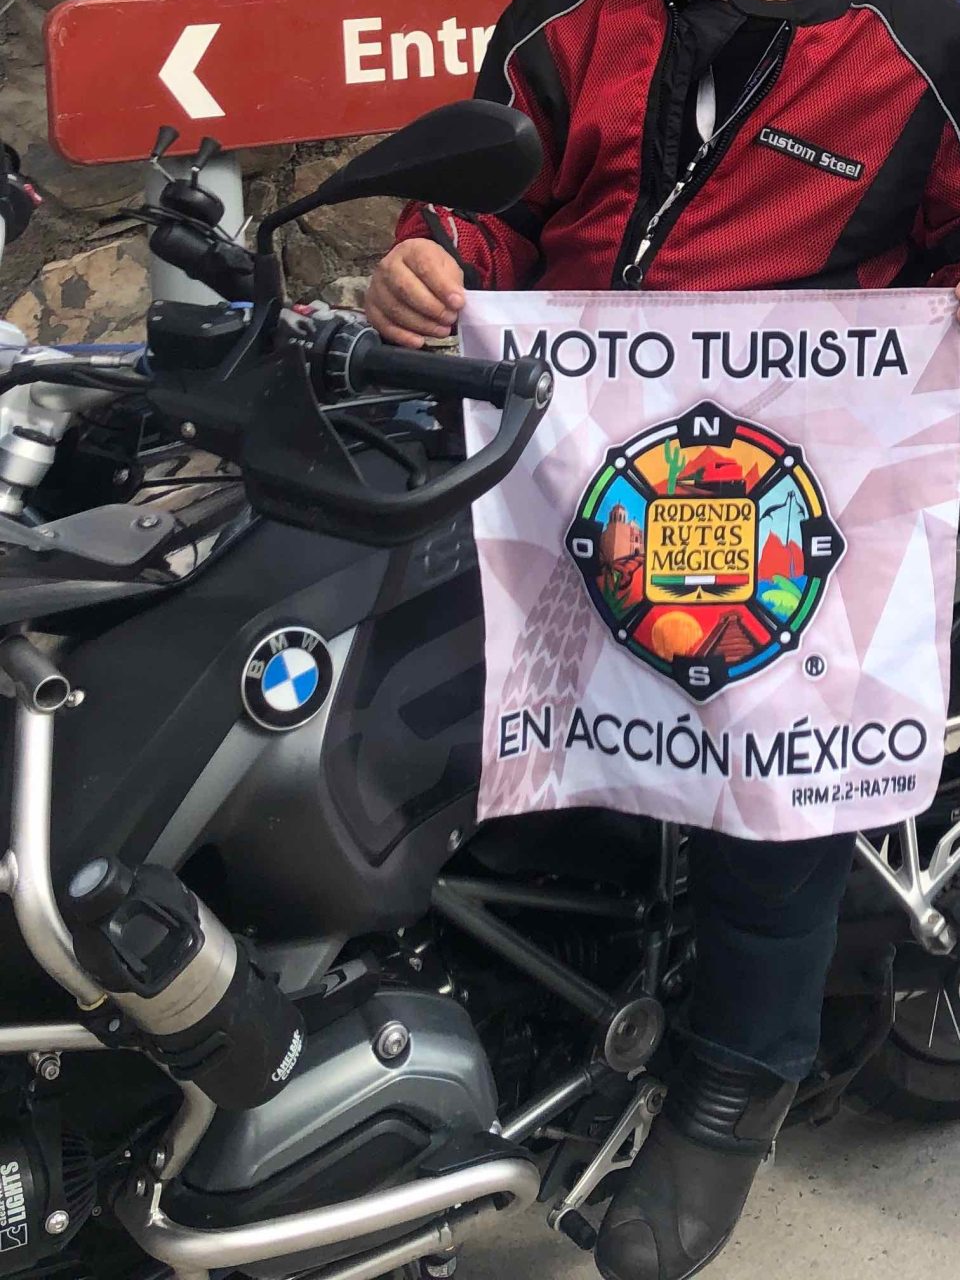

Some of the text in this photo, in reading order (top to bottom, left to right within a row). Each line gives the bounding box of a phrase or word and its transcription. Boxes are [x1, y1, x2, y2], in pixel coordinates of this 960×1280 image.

[759, 128, 862, 178] Custom Steel
[502, 328, 909, 380] MOTO TURISTA
[693, 416, 720, 436] N
[811, 536, 832, 557] E
[688, 666, 712, 686] S
[499, 705, 928, 778] EN ACCIÓN MÉXICO
[792, 786, 829, 807] RRM
[0, 1160, 27, 1224] LIGHTS
